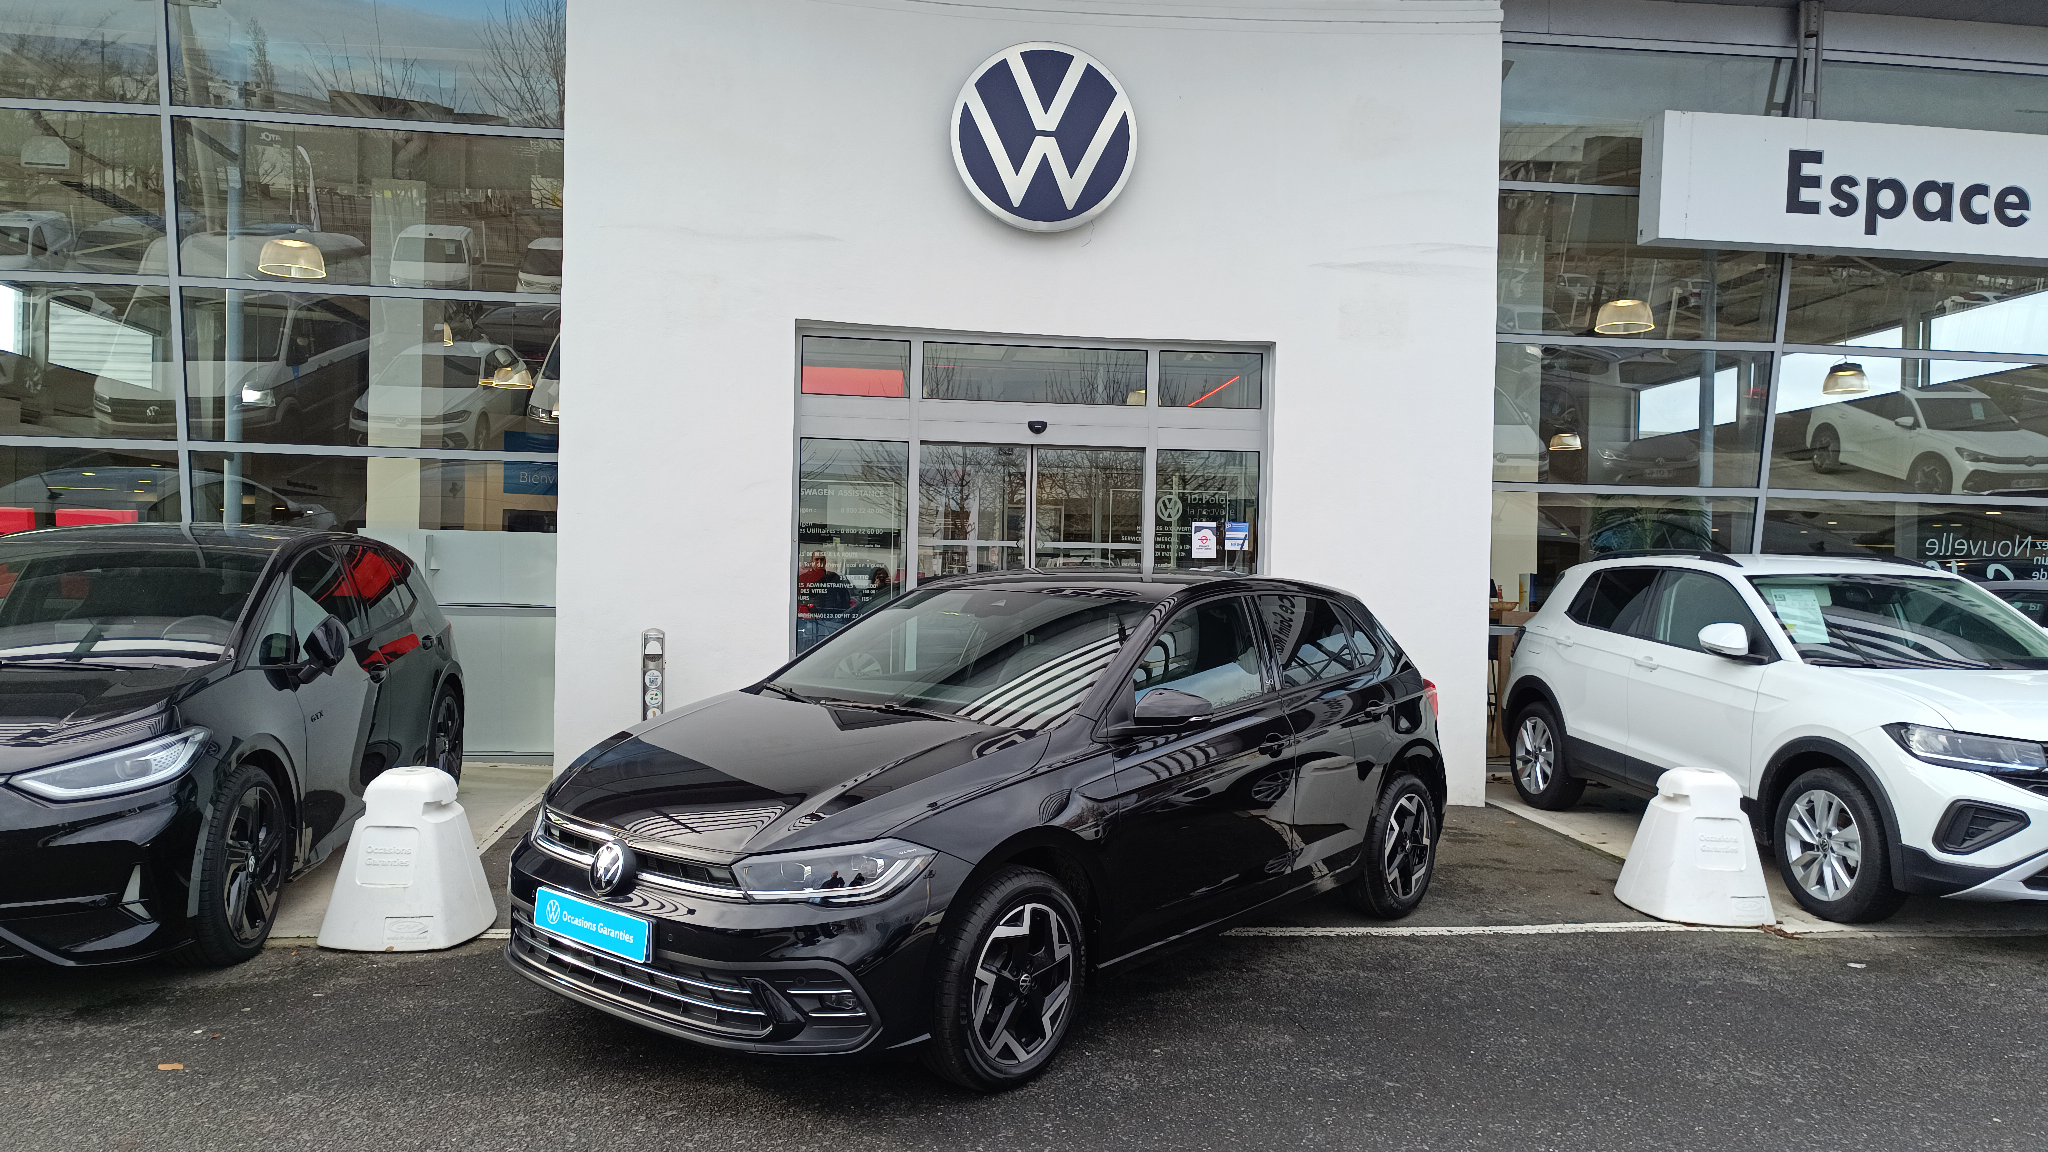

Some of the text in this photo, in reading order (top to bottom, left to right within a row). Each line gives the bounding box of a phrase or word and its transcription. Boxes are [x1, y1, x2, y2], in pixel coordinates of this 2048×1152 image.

[1786, 148, 2032, 236] Espace
[519, 471, 557, 484] Bienv
[837, 489, 884, 498] ASSISTANCE
[365, 845, 412, 855] Occasions
[365, 857, 410, 867] Garanties
[562, 911, 634, 944] Occasions Garanties
